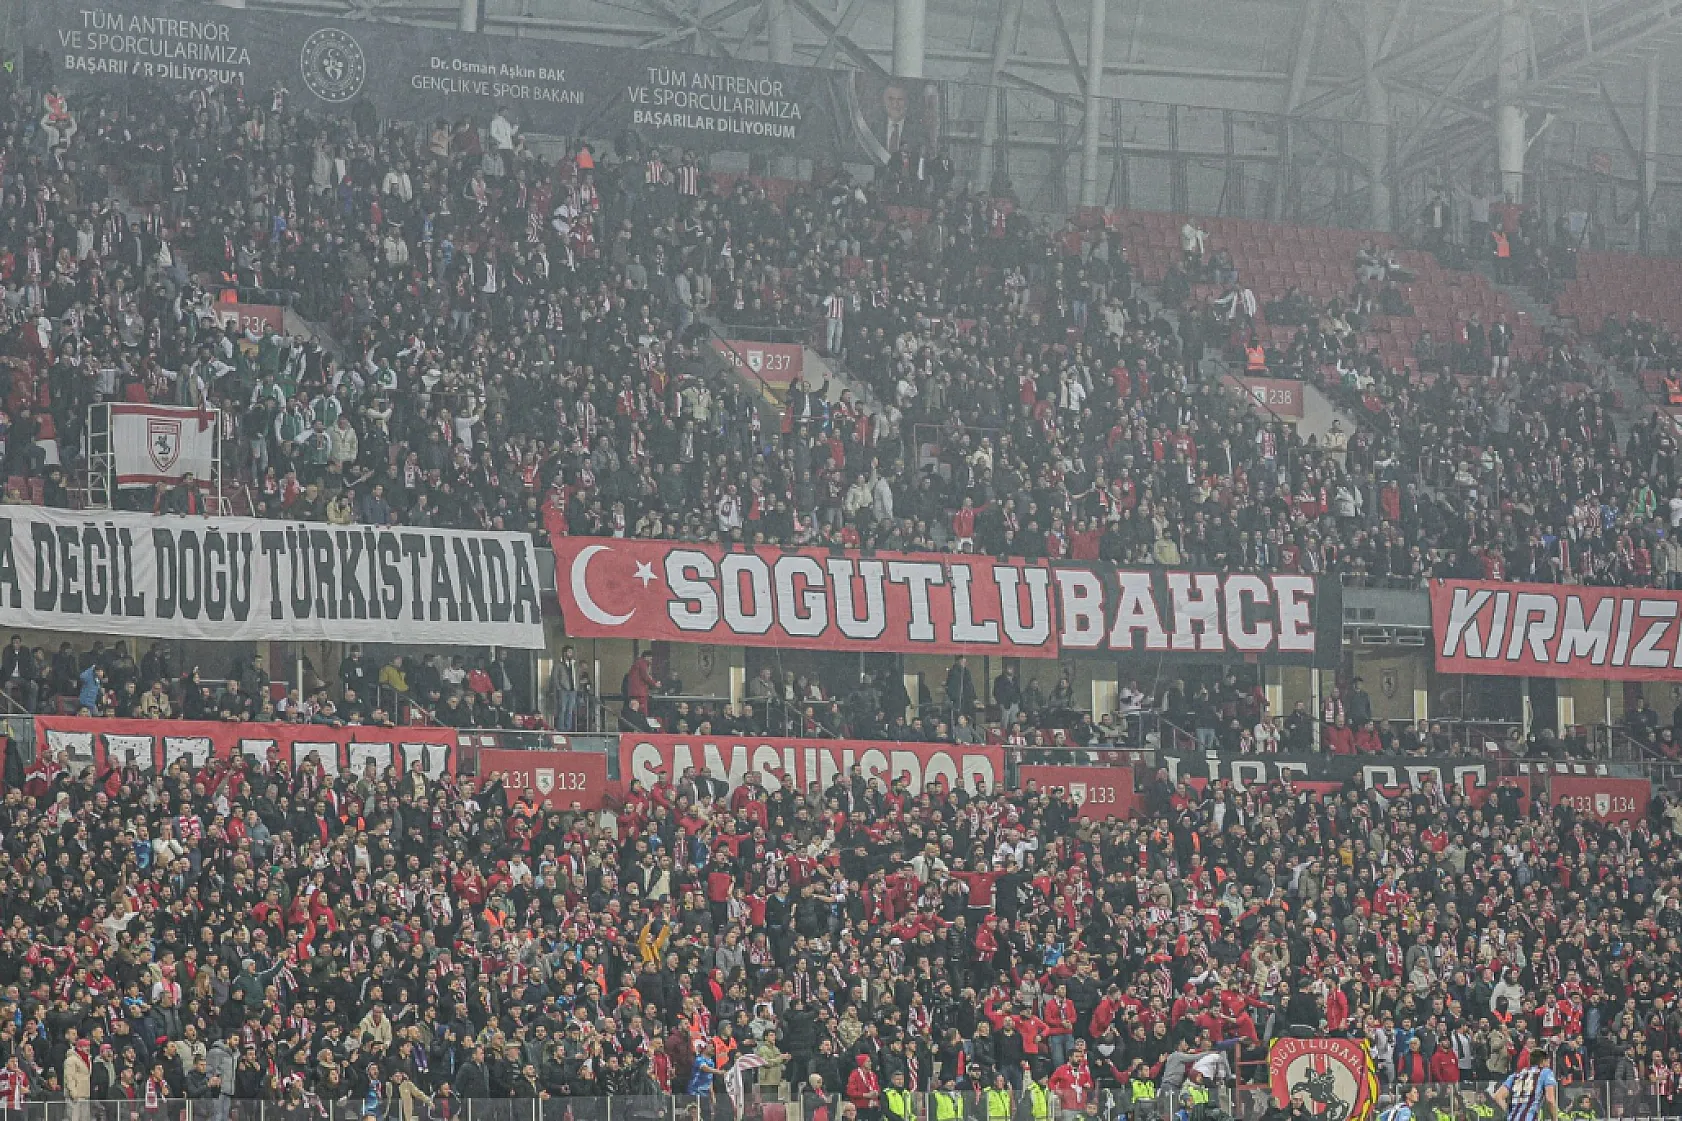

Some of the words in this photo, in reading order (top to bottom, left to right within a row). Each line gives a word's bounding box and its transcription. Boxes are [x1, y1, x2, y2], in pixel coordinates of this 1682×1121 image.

[80, 8, 124, 32] TÜM
[128, 15, 230, 42] ANTRENÖR
[58, 29, 82, 49] VE
[87, 32, 251, 65] SPORCULARIMIZA
[431, 56, 449, 70] Dr.
[452, 59, 496, 75] Osman
[538, 68, 566, 82] BAK
[647, 65, 687, 87] TÜM
[691, 72, 784, 98] ANTRENÖR
[411, 74, 470, 96] GENÇLİK
[471, 81, 490, 96] VE
[493, 82, 530, 99] SPOR
[534, 87, 585, 104] BAKANI
[627, 86, 649, 104] VE
[653, 88, 802, 120] SPORCULARIMIZA
[633, 110, 714, 129] BAŞARILAR
[718, 116, 796, 139] DİLİYORUM
[766, 354, 791, 370] 237
[1269, 389, 1292, 404] 238
[31, 520, 145, 617] DEĞİL
[152, 526, 253, 622] DOĞU
[260, 523, 542, 624] TÜRKİSTANDA
[558, 772, 587, 790] 132
[1089, 787, 1116, 803] 133
[1612, 797, 1637, 813] 134
